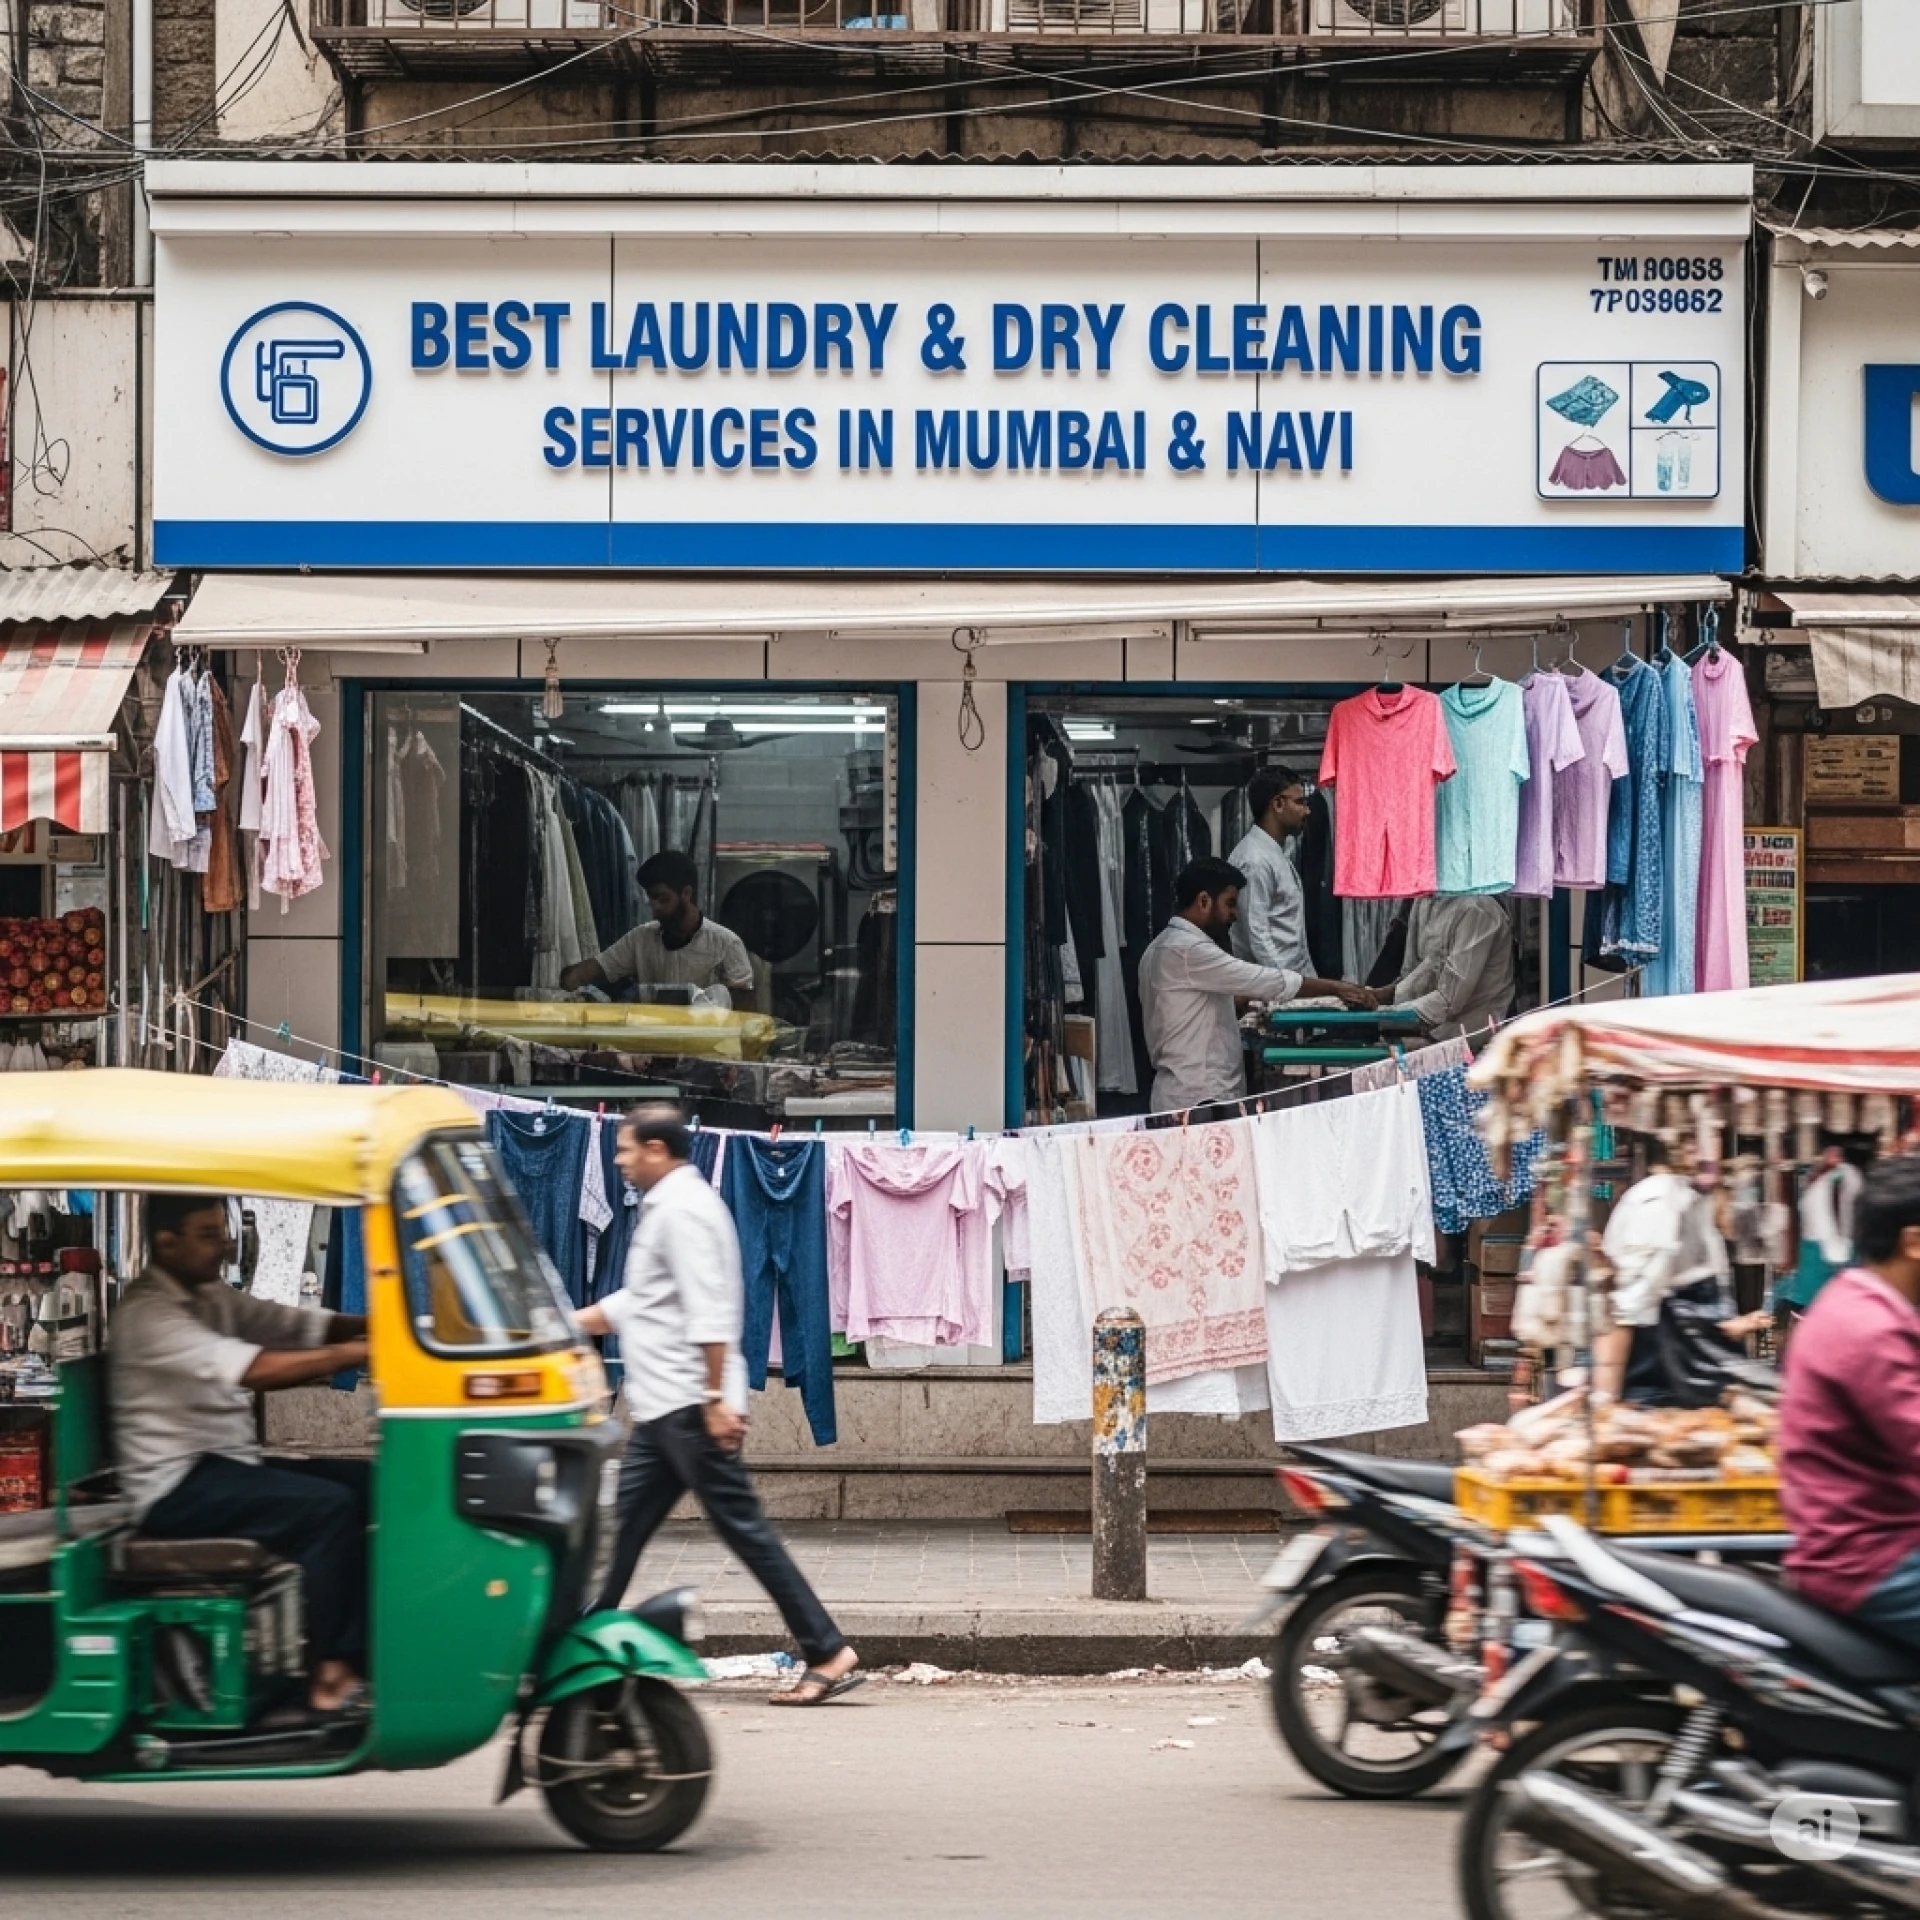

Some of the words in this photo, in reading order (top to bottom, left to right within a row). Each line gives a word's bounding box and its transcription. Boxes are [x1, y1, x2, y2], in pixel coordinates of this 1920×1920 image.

[411, 300, 571, 370] BEST
[591, 301, 897, 371] LAUNDRY
[920, 303, 966, 372] &
[991, 303, 1125, 372] DRY
[1148, 303, 1482, 374] CLEANING
[543, 405, 818, 470] SERVICES
[838, 408, 894, 468] IN
[915, 409, 1147, 470] MUMBAI
[1167, 410, 1206, 471] &
[1226, 411, 1354, 471] NAVI
